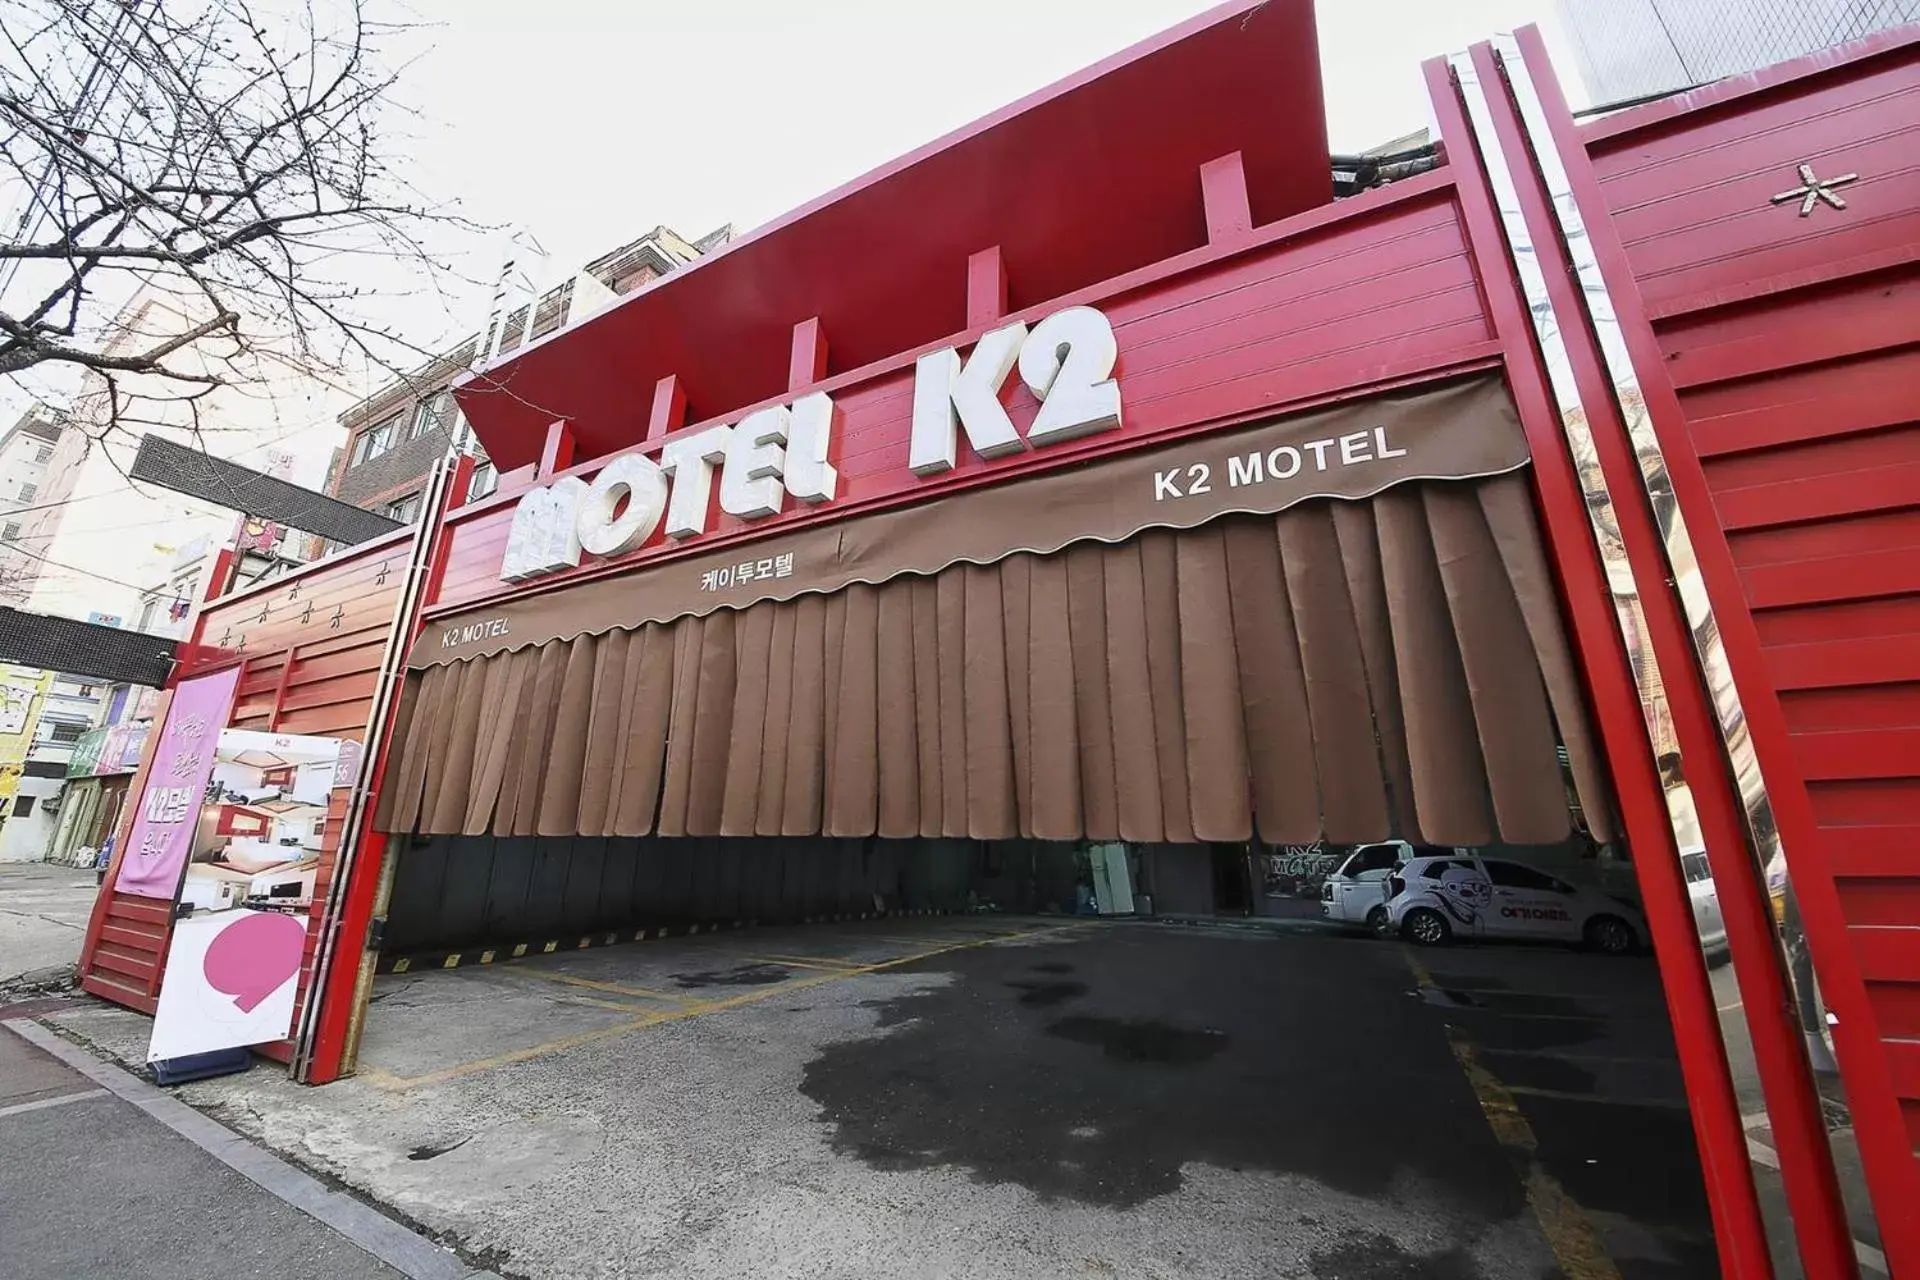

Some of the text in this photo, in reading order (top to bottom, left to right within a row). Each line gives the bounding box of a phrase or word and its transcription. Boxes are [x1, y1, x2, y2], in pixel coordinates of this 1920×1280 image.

[500, 306, 1122, 584] MOTEL K2
[1154, 426, 1407, 500] K2 MOTEL
[701, 552, 794, 591] 케이투모텔
[441, 618, 509, 648] K2 MOTEL
